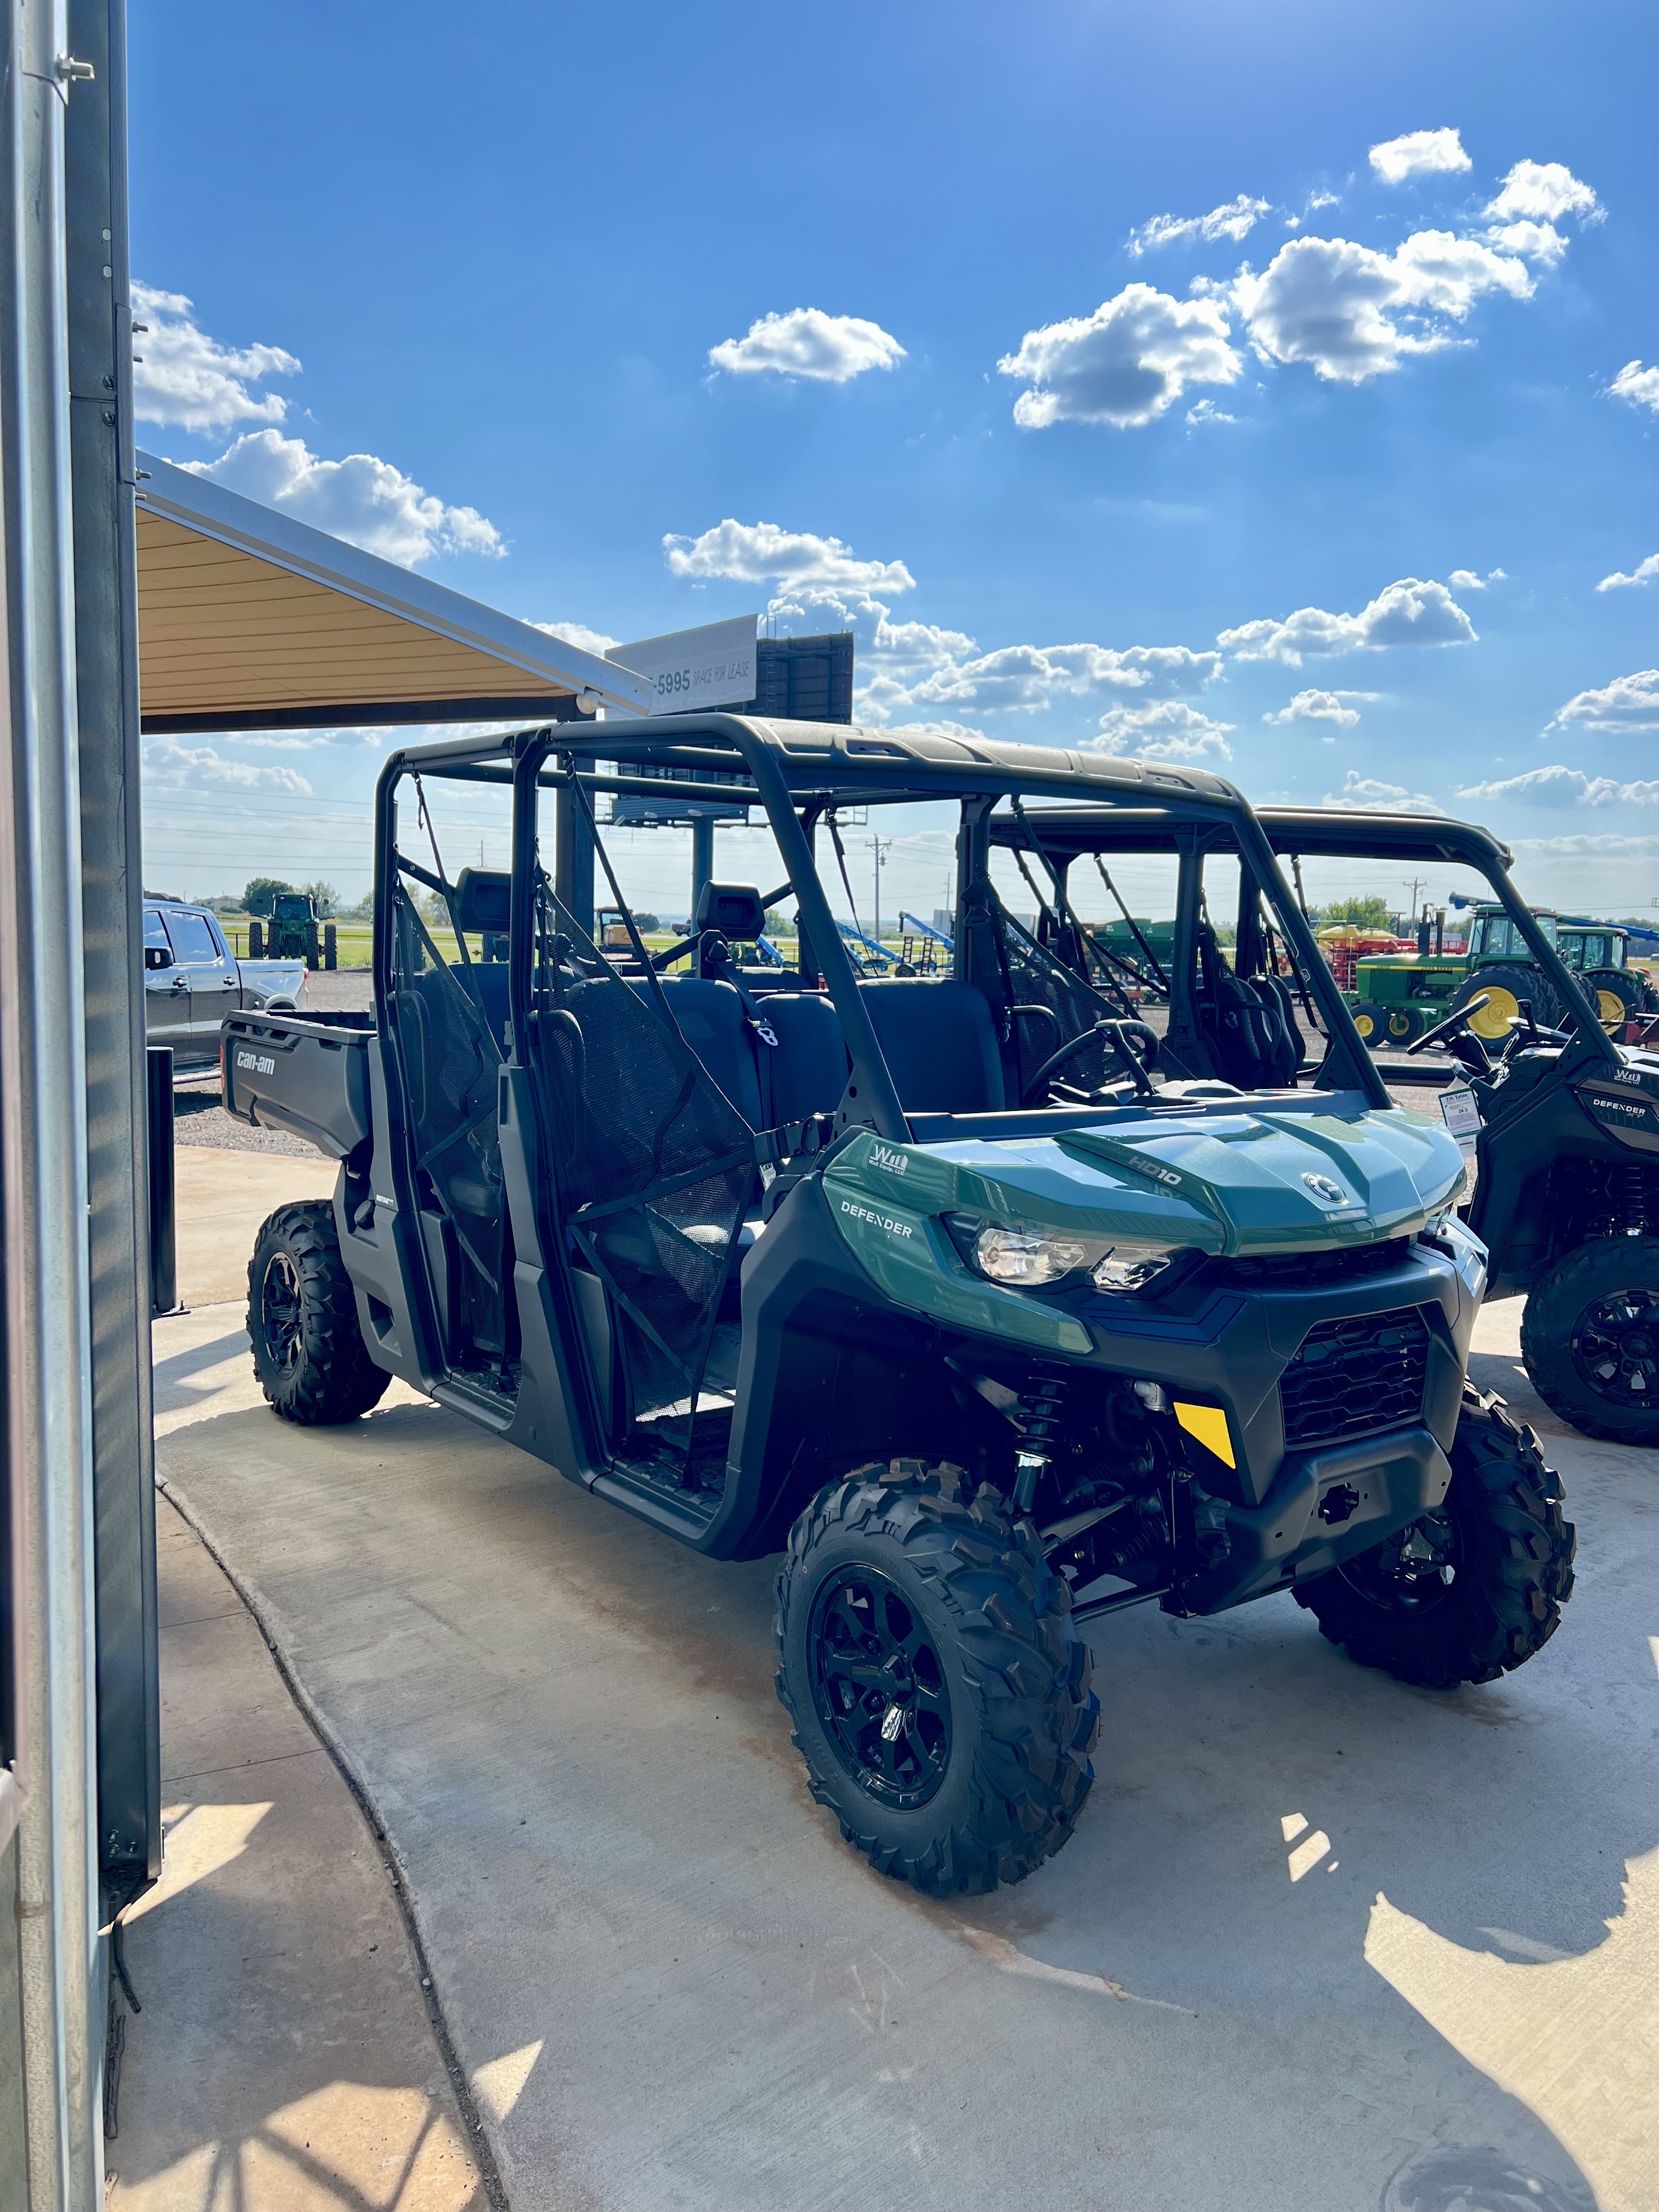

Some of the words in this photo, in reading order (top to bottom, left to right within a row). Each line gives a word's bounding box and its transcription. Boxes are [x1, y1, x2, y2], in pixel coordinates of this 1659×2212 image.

[693, 668, 713, 685] SPACE
[714, 665, 725, 682] FOR
[727, 661, 749, 679] LEASE
[1593, 1099, 1645, 1115] DEFENDER
[1128, 1155, 1182, 1185] HD10
[841, 1200, 912, 1238] DEFENDER
